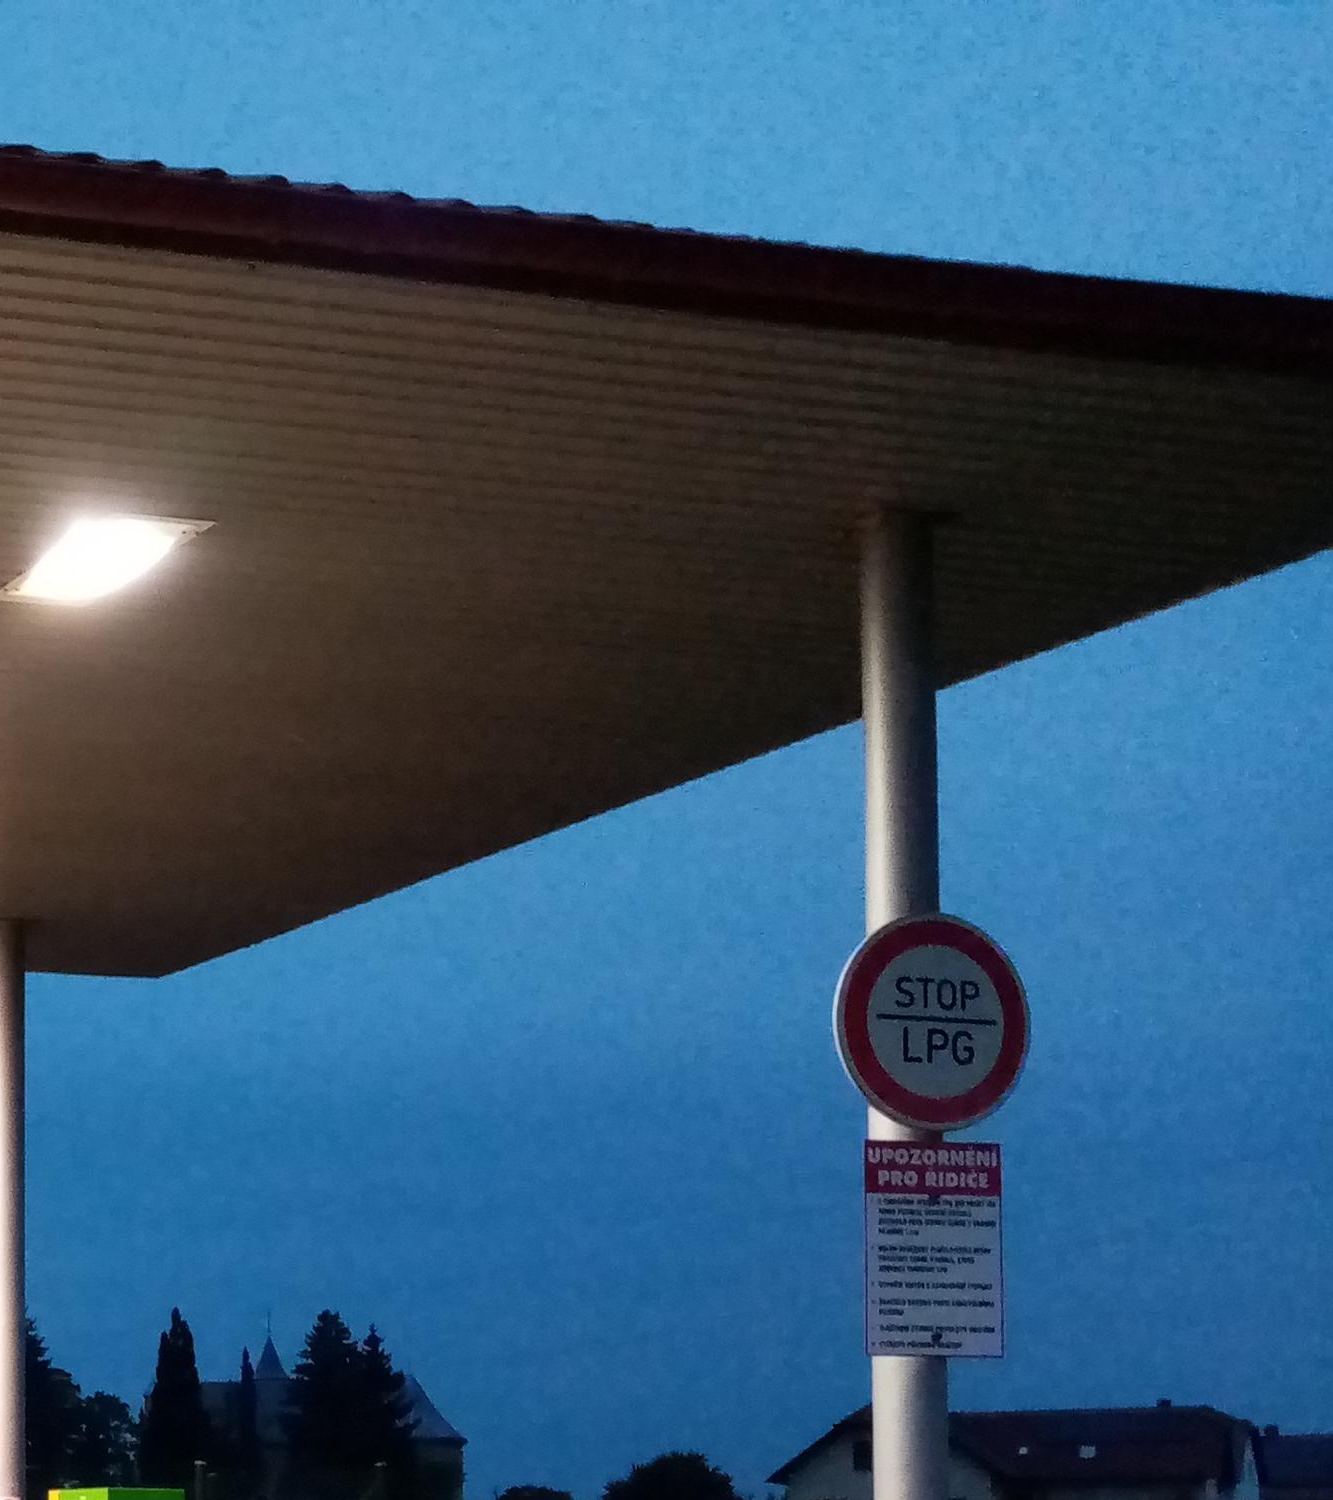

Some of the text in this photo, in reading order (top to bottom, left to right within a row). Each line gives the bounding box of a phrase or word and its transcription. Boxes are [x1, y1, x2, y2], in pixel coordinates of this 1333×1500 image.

[895, 976, 981, 1011] STOP
[902, 1027, 976, 1066] LPG
[868, 1145, 998, 1167] UPOZORNĚNÍ
[878, 1170, 919, 1187] PRO
